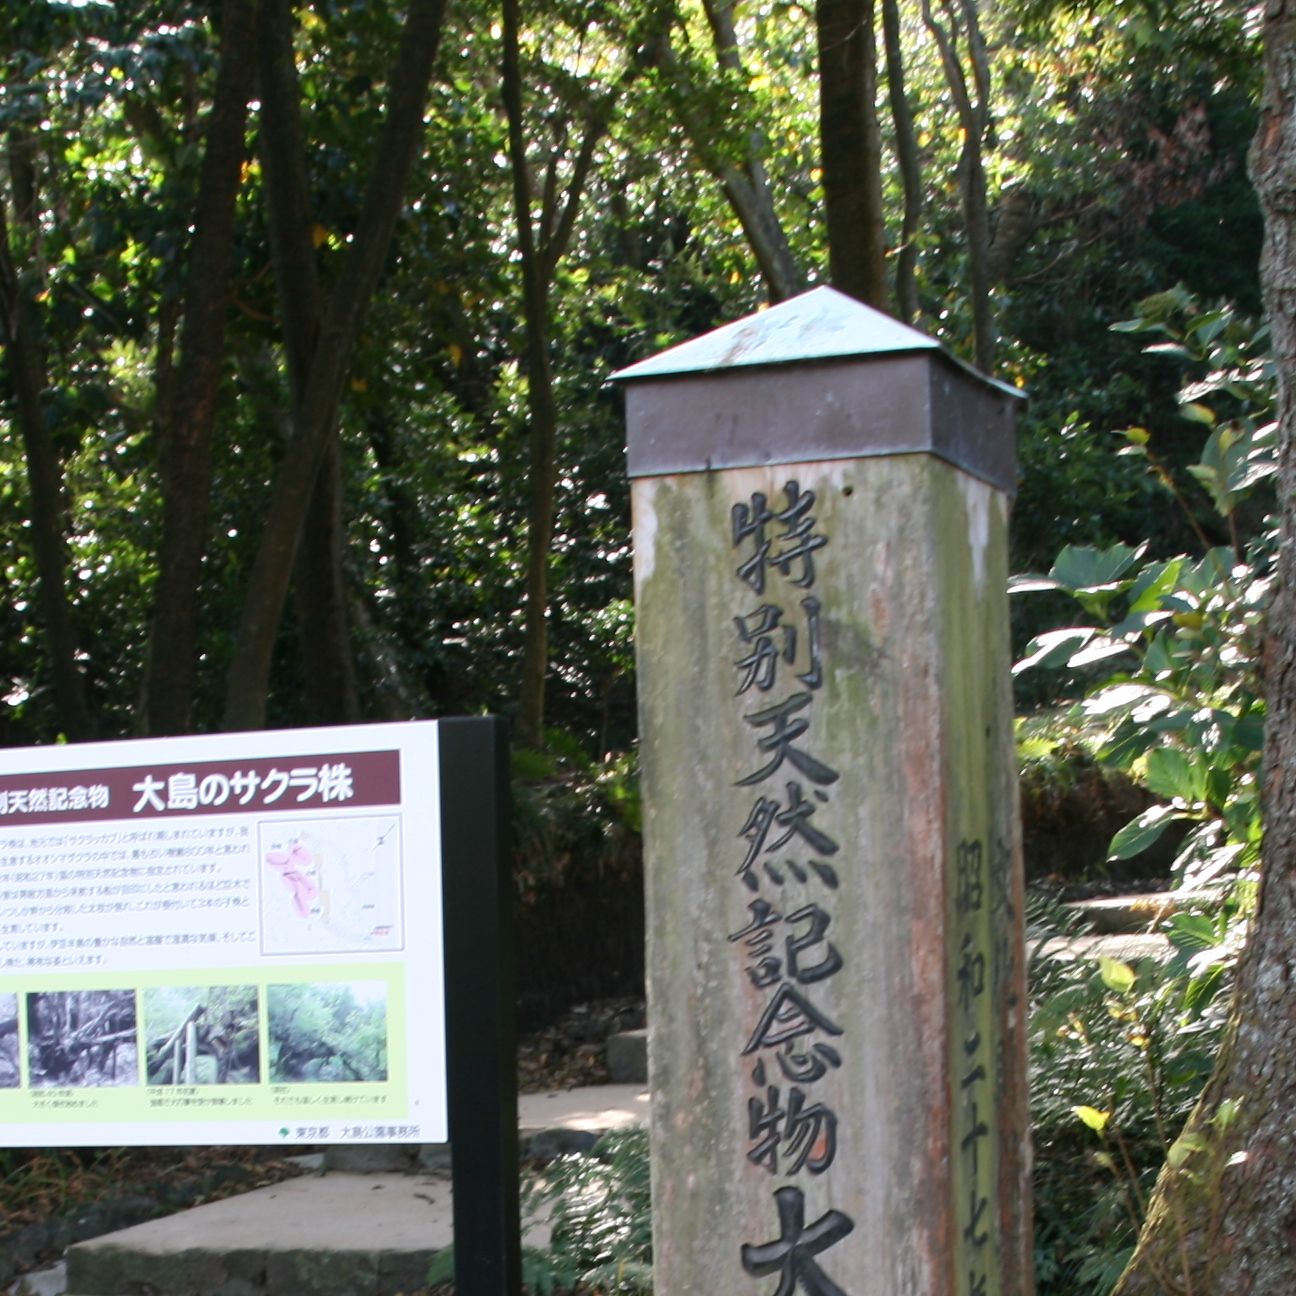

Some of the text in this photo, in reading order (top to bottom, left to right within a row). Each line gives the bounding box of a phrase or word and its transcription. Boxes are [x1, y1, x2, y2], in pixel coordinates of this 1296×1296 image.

[132, 762, 355, 813] 大島のサクラ株
